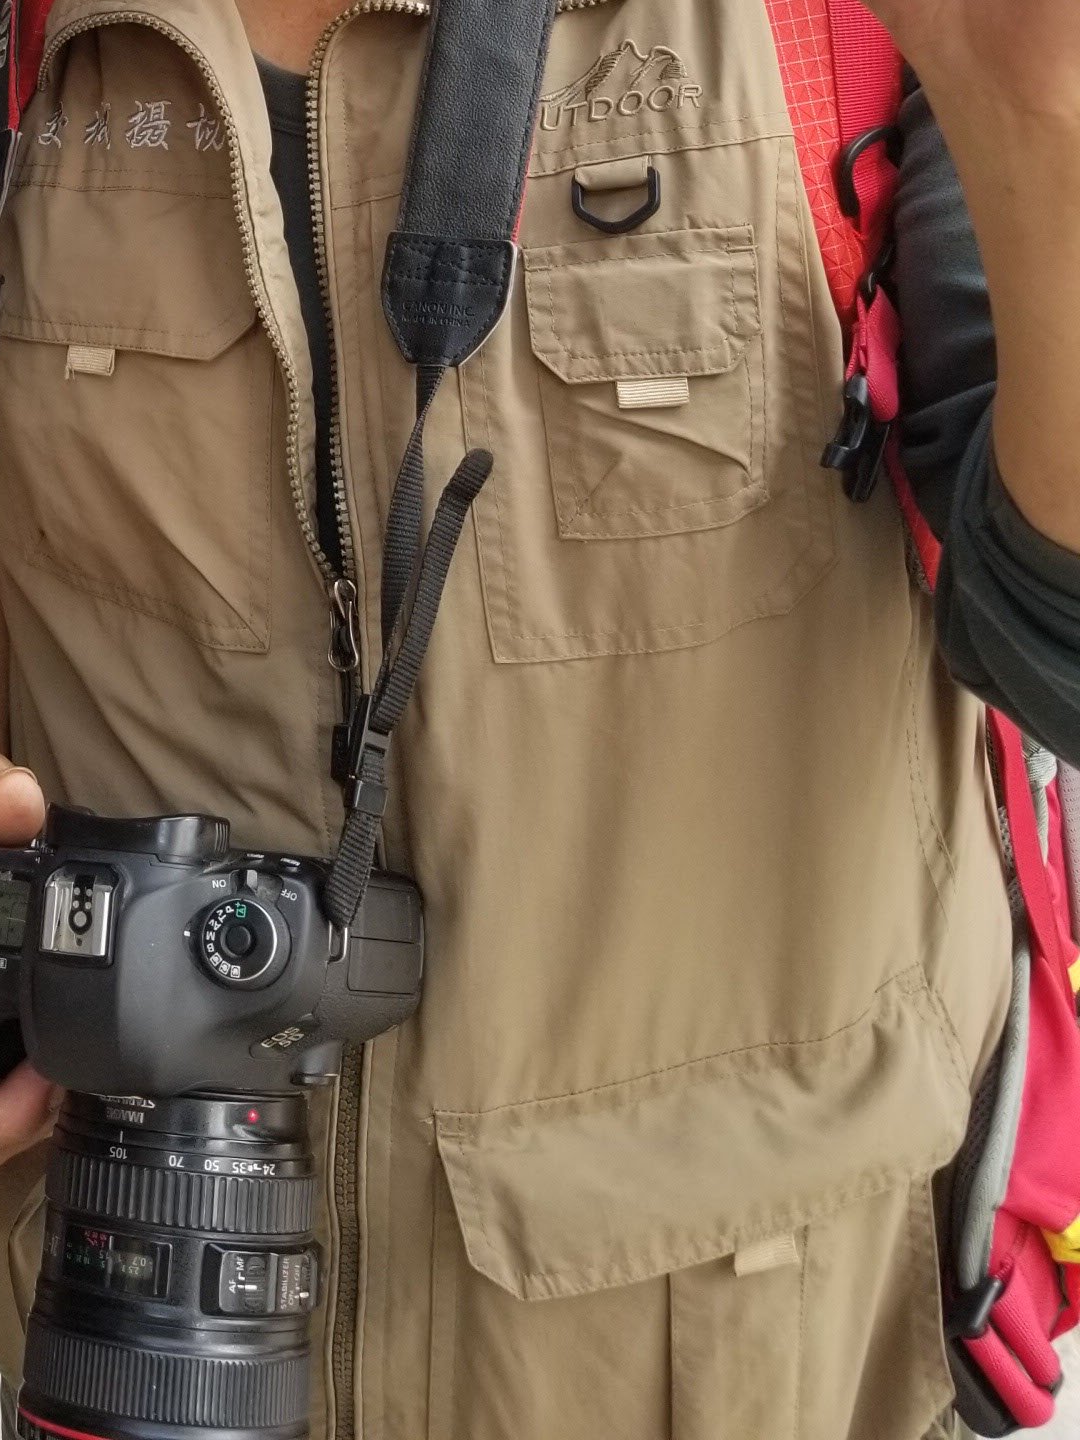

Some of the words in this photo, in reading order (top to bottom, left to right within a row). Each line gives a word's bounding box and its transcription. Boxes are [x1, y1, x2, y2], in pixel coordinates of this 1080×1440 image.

[540, 84, 703, 131] UTDOOR
[212, 879, 226, 888] ON
[281, 889, 297, 901] OFF
[206, 931, 215, 941] M
[207, 943, 214, 953] B
[260, 1026, 300, 1048] EOS
[109, 1146, 128, 1160] 105
[168, 1155, 184, 1169] 70
[204, 1159, 220, 1172] 50
[232, 1161, 246, 1174] 35
[262, 1163, 275, 1176] 24
